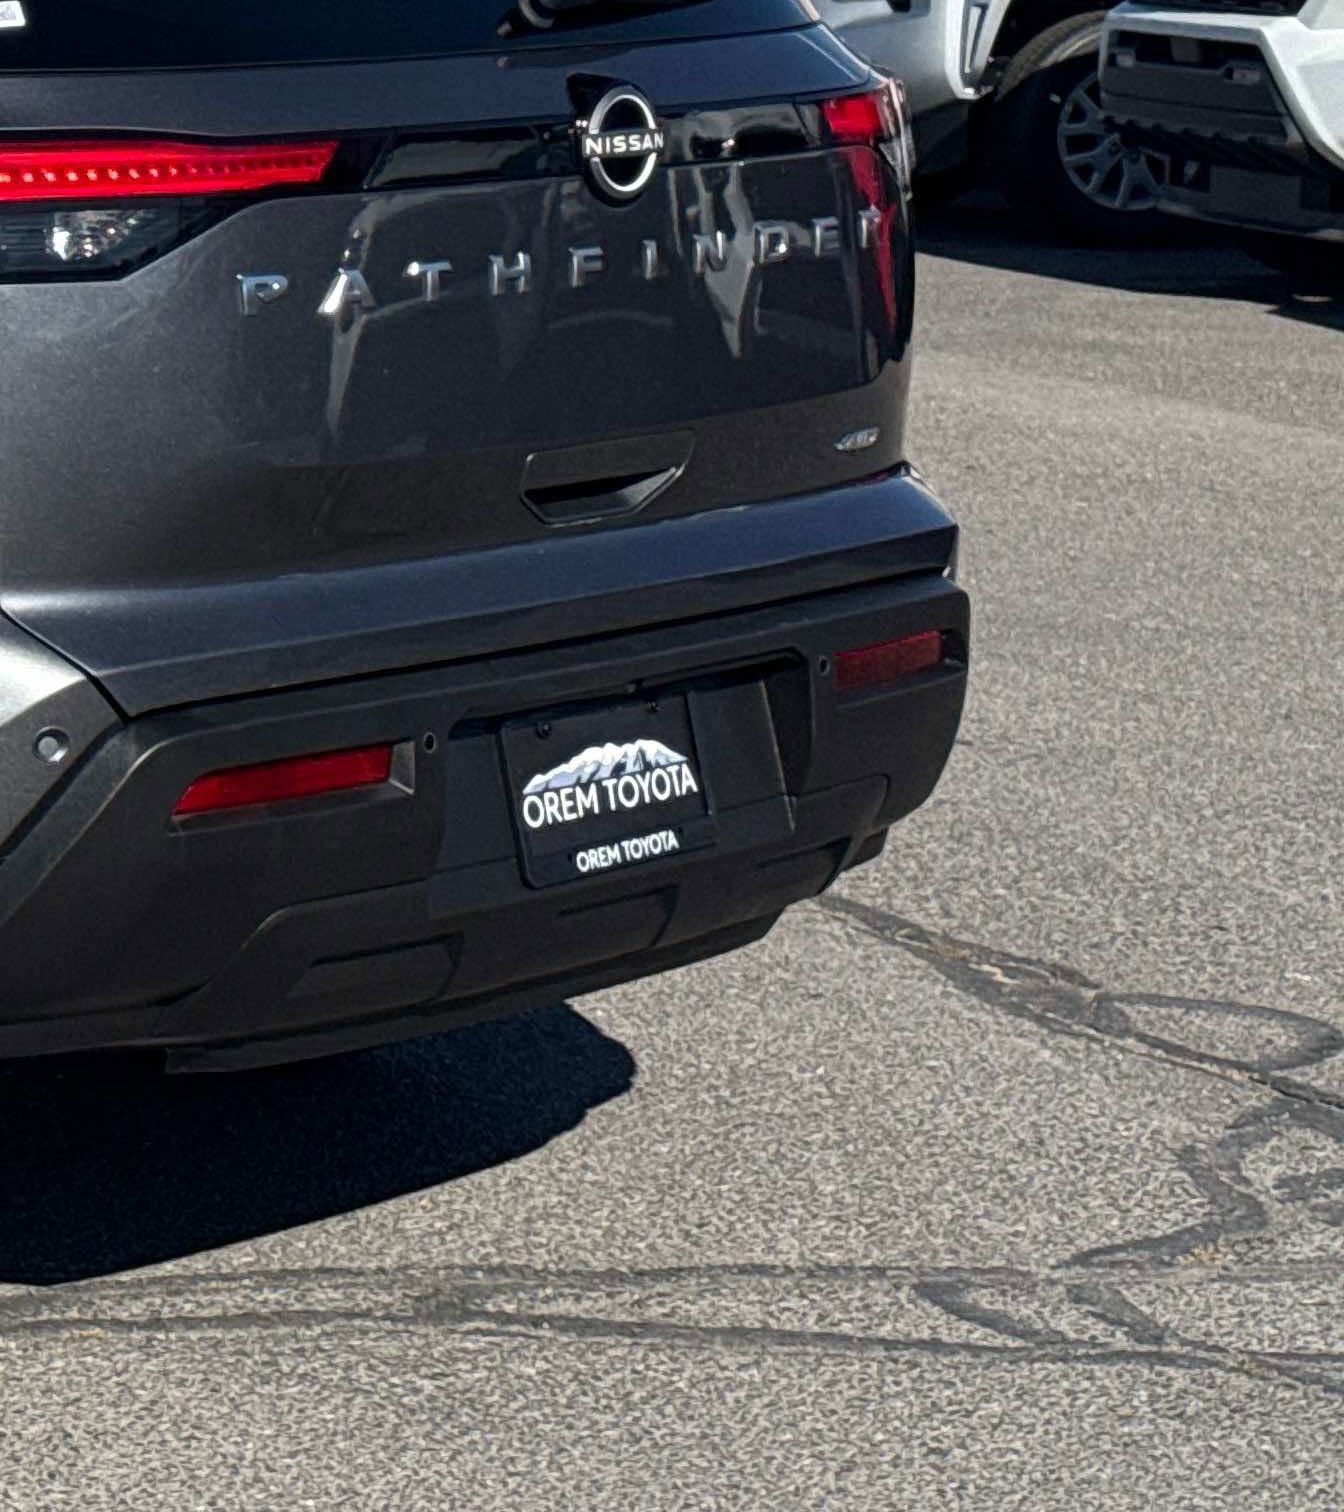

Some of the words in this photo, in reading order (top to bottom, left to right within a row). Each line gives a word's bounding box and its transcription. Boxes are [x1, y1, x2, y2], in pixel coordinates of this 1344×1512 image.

[585, 133, 664, 155] NISSAN
[523, 783, 600, 828] OREM
[602, 763, 698, 812] TOYOTA
[576, 844, 622, 872] OREM
[620, 829, 680, 862] TOYOTA
